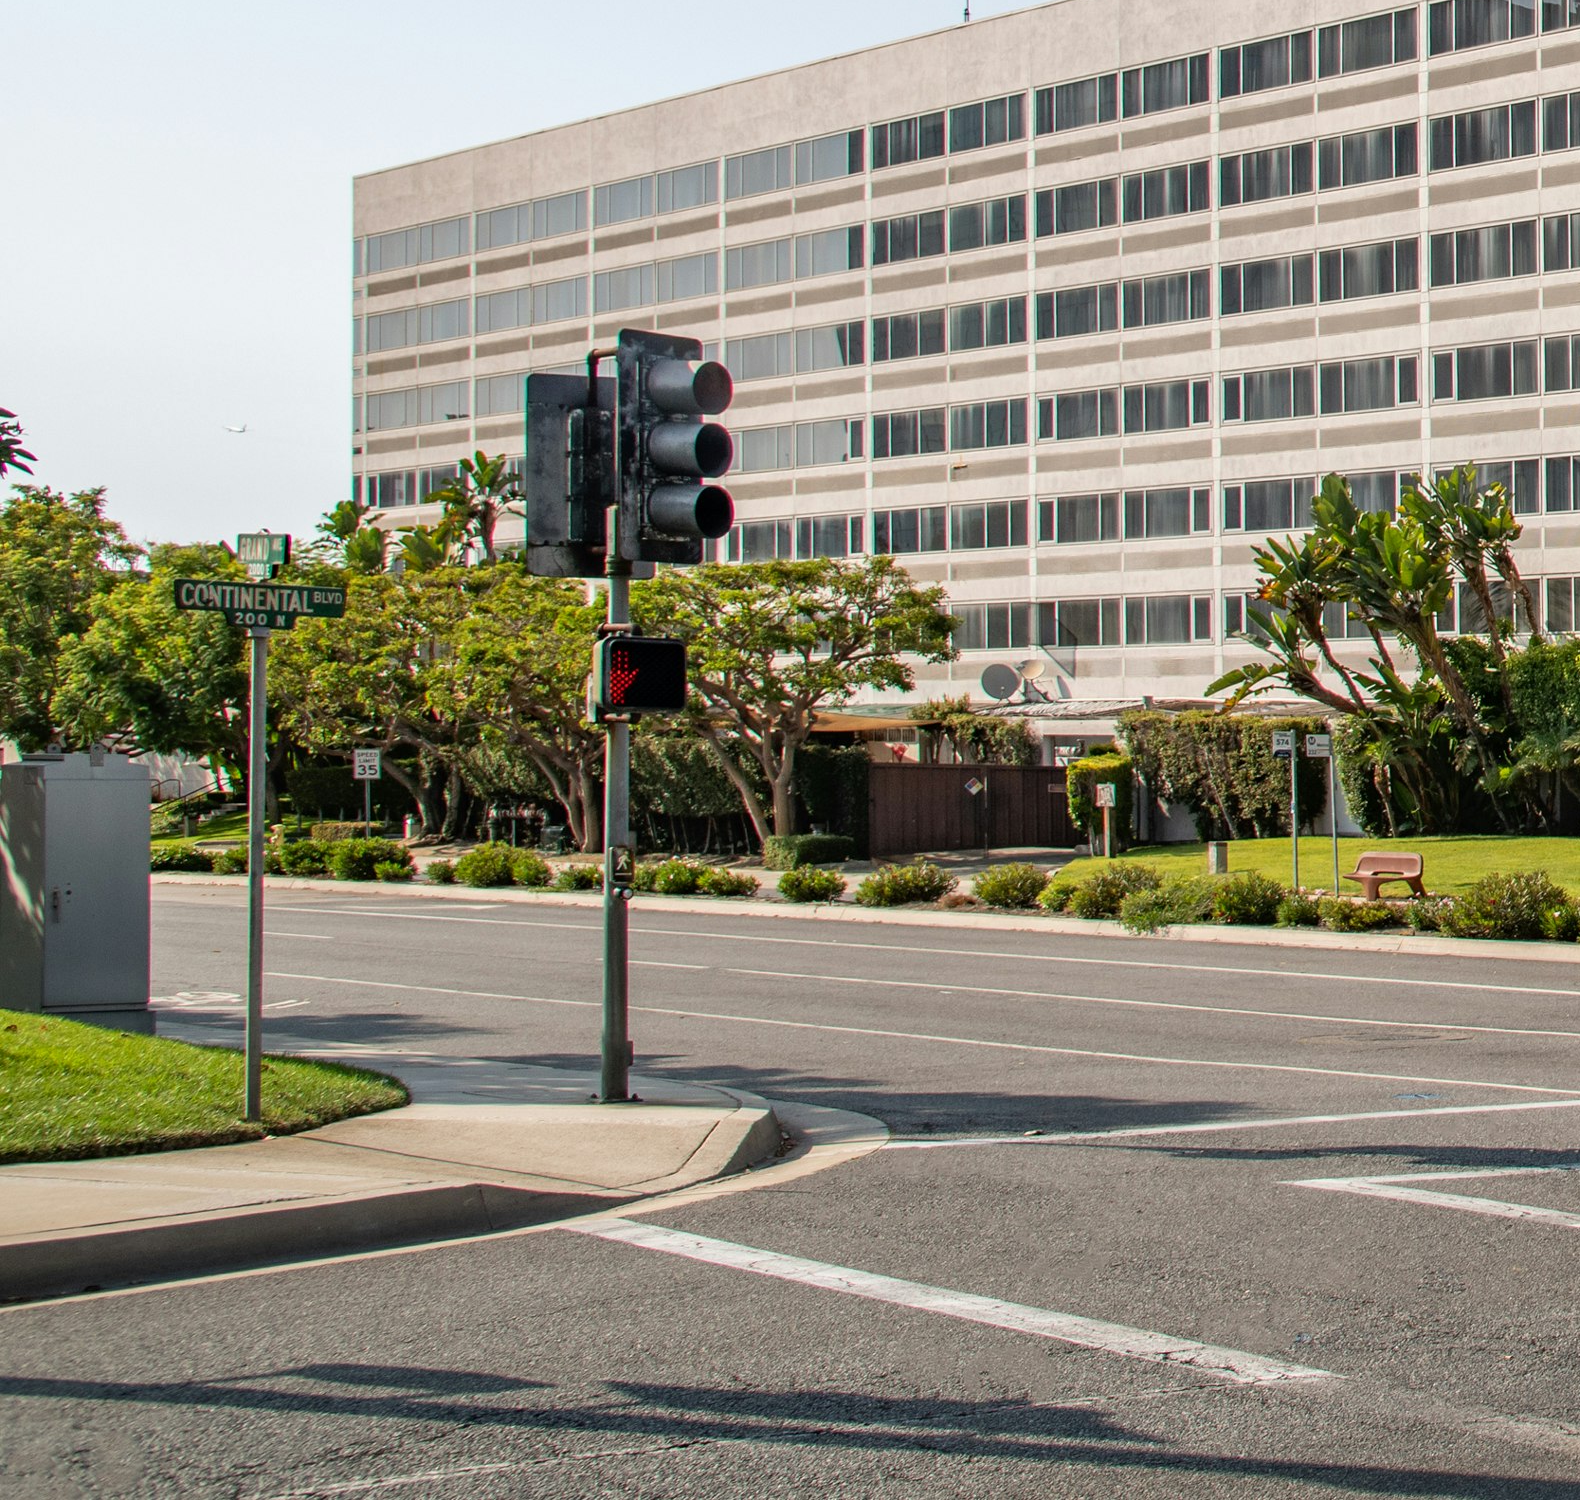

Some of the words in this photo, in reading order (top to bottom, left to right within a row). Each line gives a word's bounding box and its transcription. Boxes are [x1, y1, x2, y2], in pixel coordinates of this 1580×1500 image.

[239, 536, 270, 562] GRAND
[181, 582, 314, 614] CONTINENTAL
[313, 591, 343, 605] BLVD
[235, 612, 268, 626] 200
[276, 614, 286, 627] N
[1276, 738, 1290, 746] 574
[358, 764, 378, 776] 35
